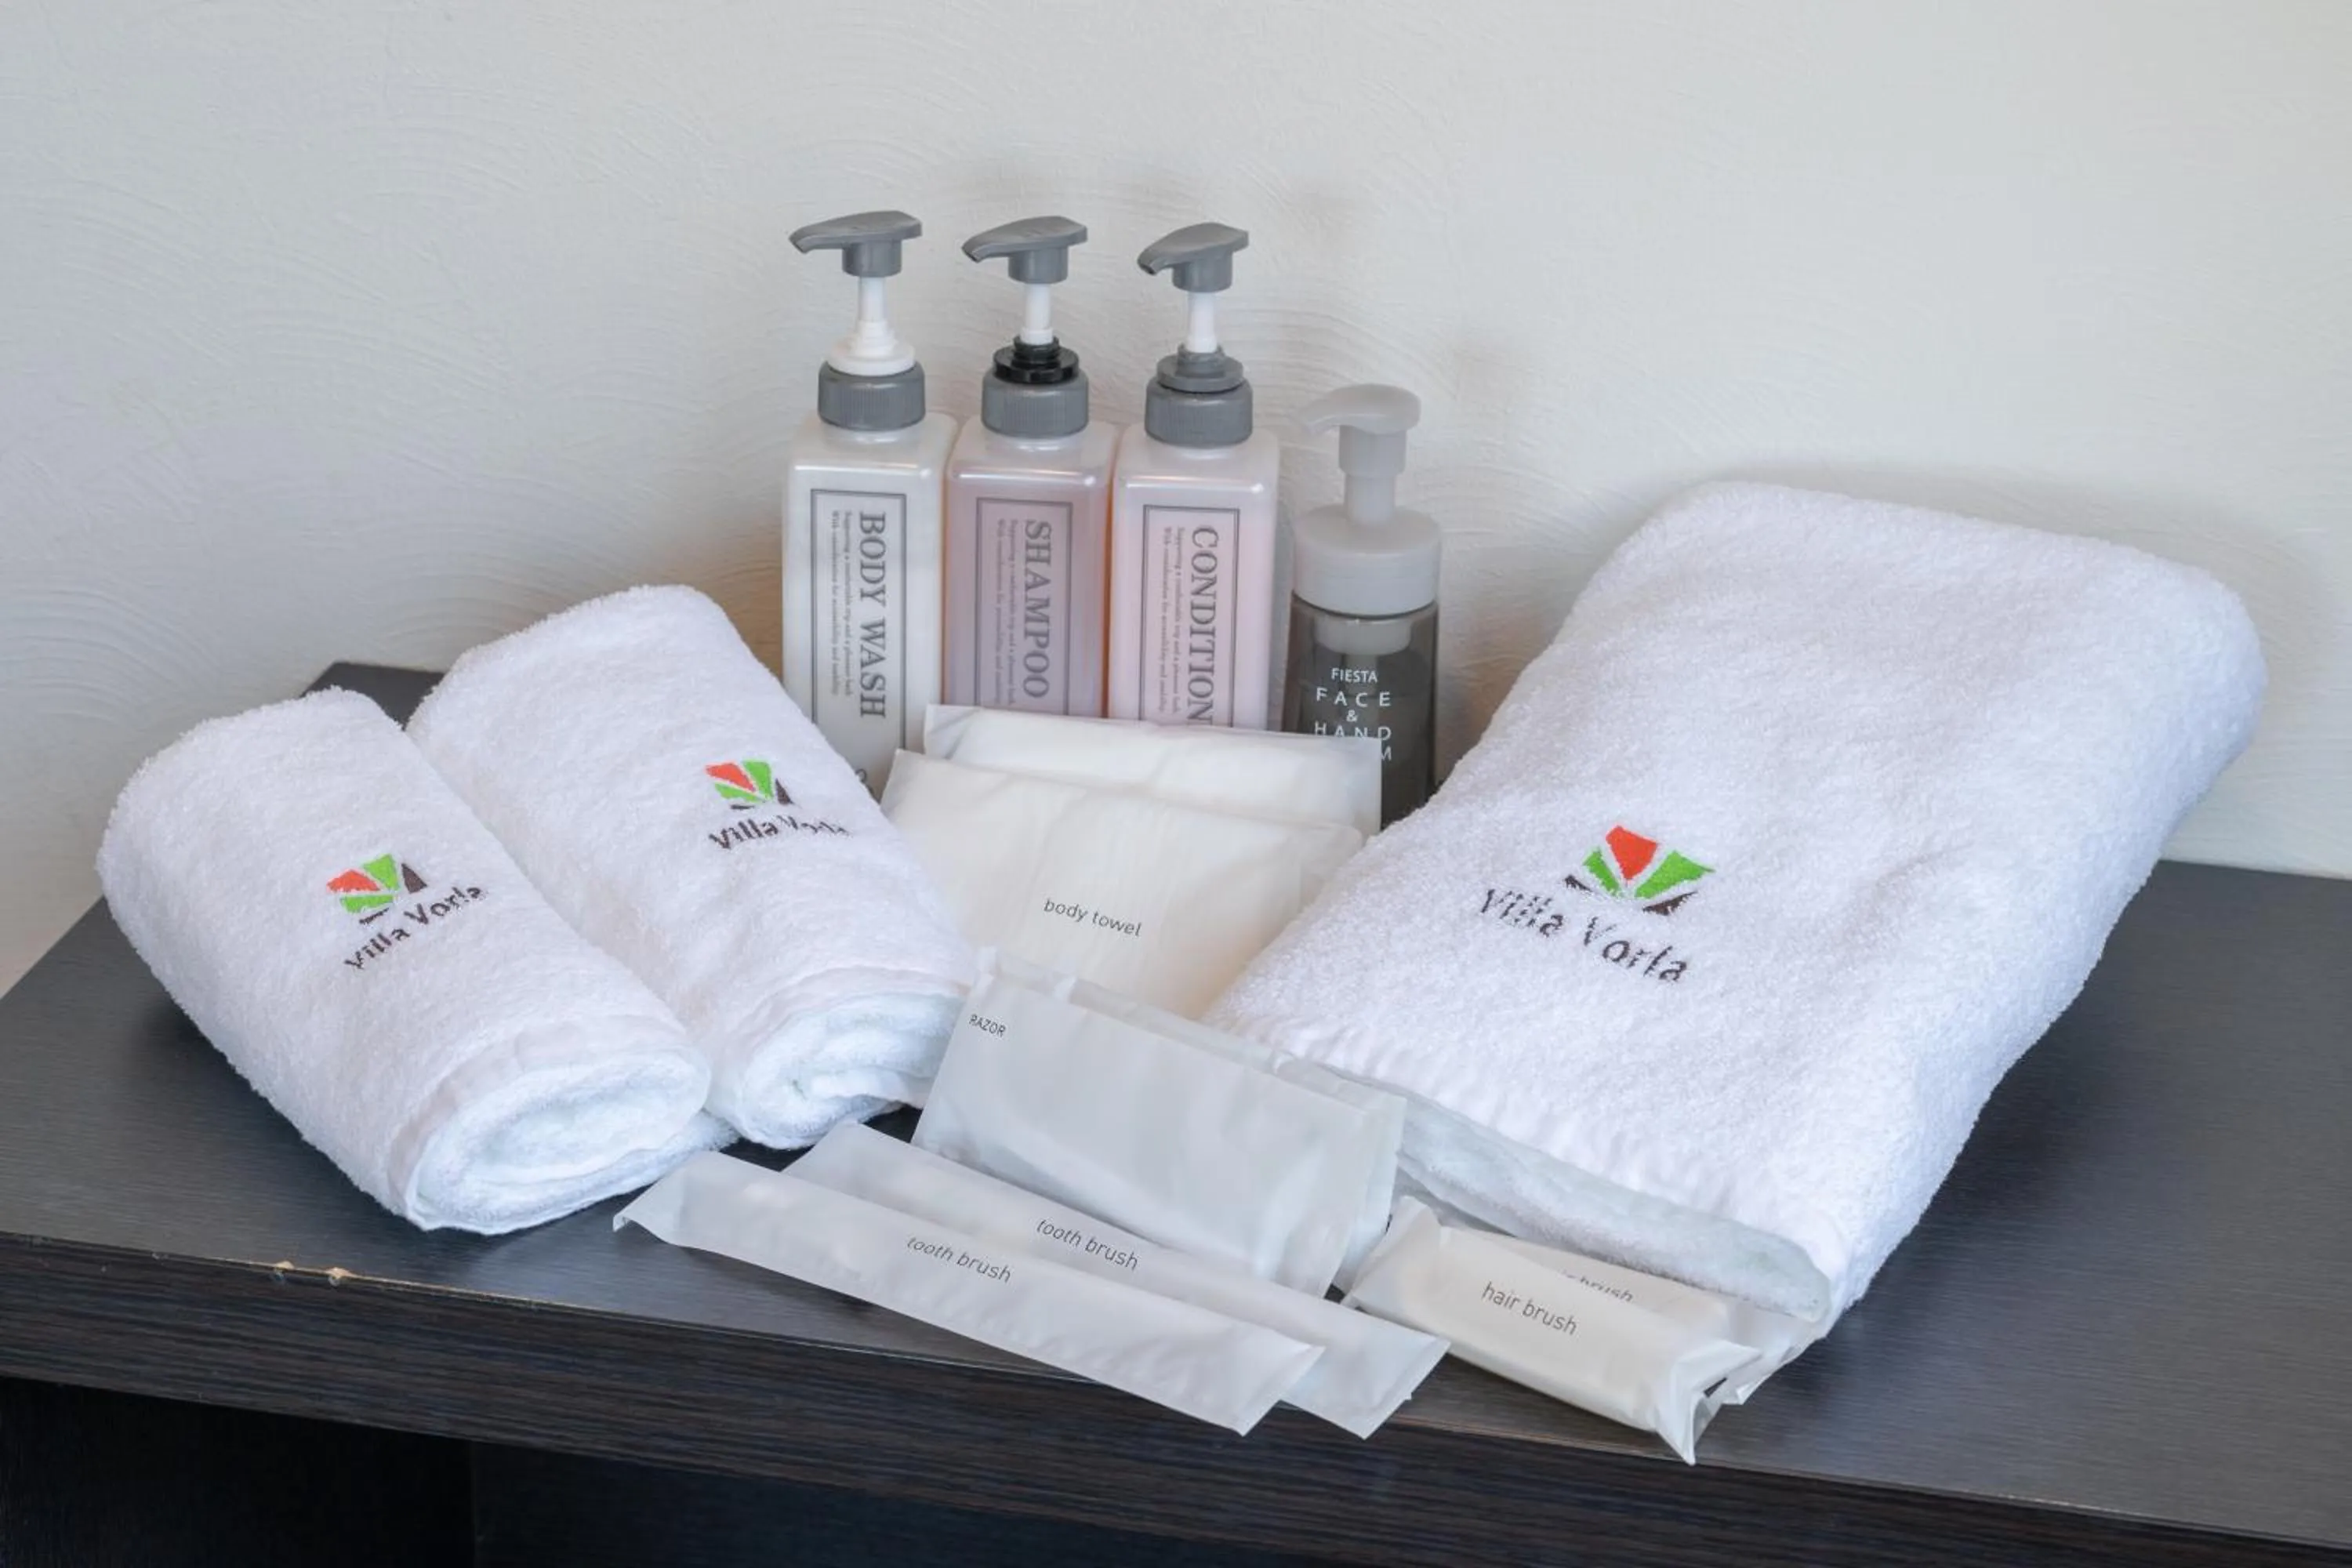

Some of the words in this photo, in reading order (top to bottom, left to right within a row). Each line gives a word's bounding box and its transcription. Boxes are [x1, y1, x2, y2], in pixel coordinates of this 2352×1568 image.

[860, 511, 887, 607] BODY
[1023, 520, 1052, 699] SHAMPOO
[1187, 526, 1219, 726] CONDITION
[860, 619, 887, 718] WASH
[1330, 667, 1378, 684] FIESTA
[1316, 687, 1392, 707] FACE
[1345, 709, 1358, 722] &
[1314, 720, 1392, 741] HAND
[709, 818, 779, 850] Villa
[343, 928, 411, 970] Villa
[403, 887, 483, 925] Vorla
[1044, 898, 1089, 923] body
[1092, 910, 1142, 937] towel
[1481, 888, 1564, 938] Villa
[1584, 916, 1688, 982] Vorla
[968, 1014, 1006, 1037] RAZOR
[906, 1236, 953, 1261] tooth
[956, 1252, 1011, 1283] brush
[1036, 1219, 1081, 1247] tooth
[1084, 1238, 1139, 1272] brush
[1481, 1281, 1521, 1310] hair
[1522, 1298, 1577, 1336] brush
